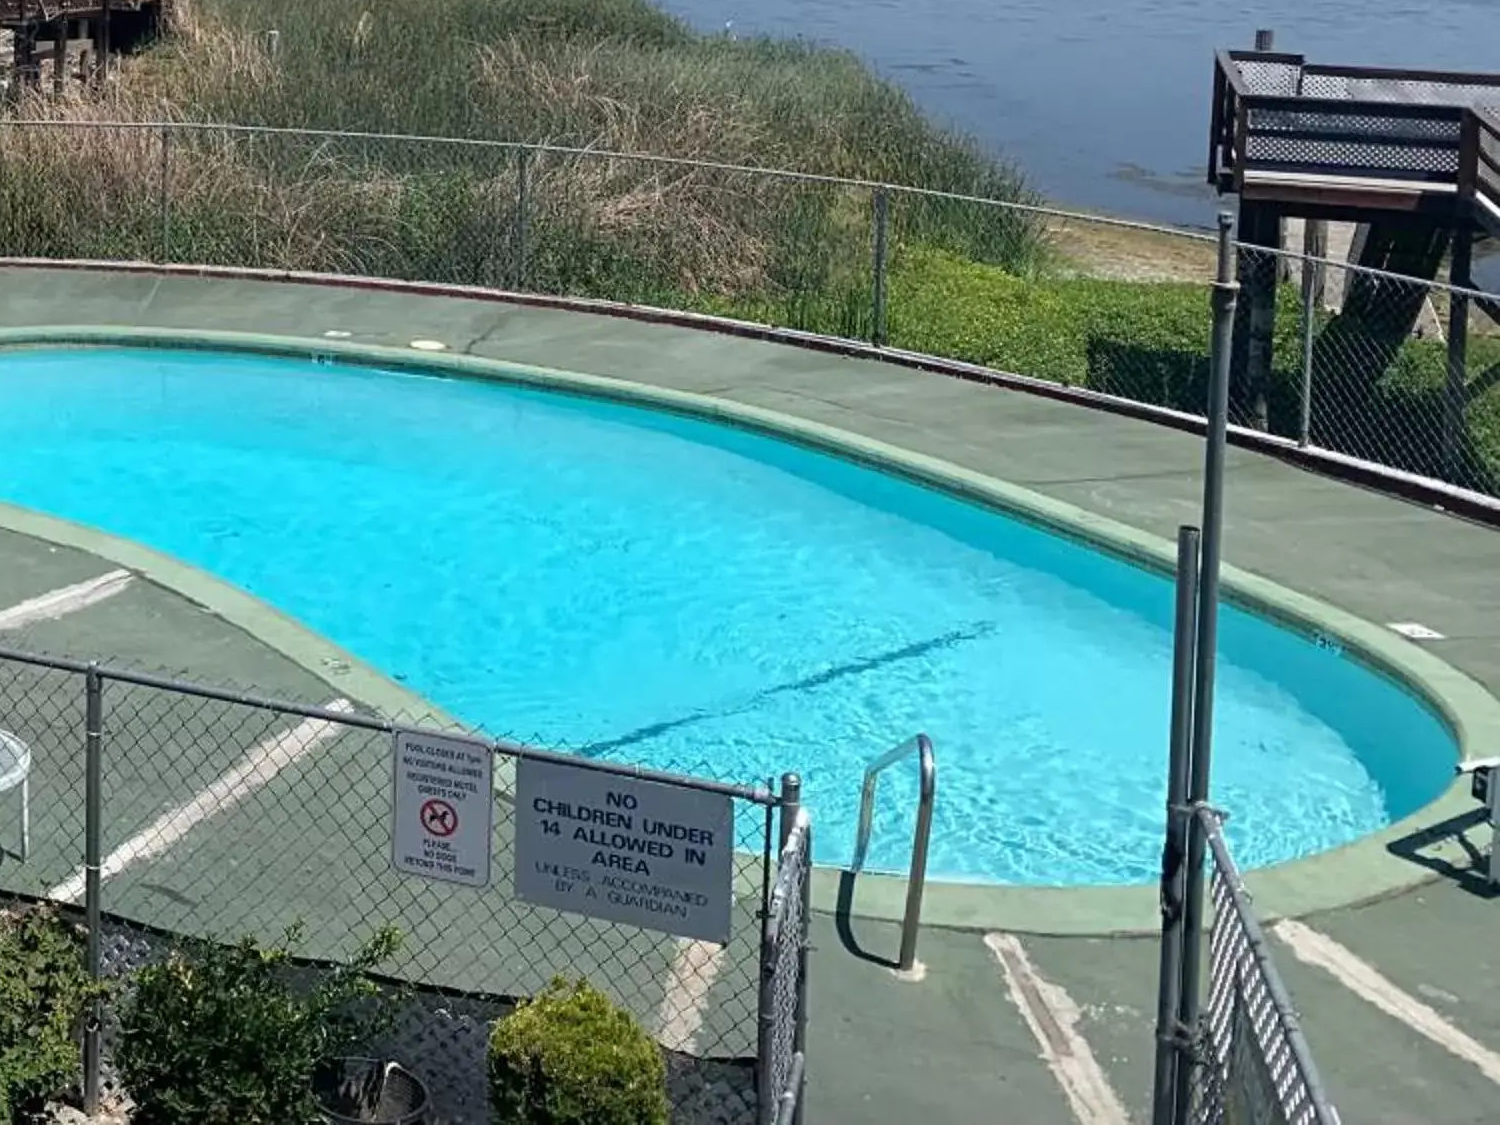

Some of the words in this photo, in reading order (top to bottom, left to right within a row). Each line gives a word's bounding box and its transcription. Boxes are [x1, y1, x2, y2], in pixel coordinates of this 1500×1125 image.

[533, 796, 633, 830] CHILDREN
[642, 818, 714, 847] UNDER
[606, 791, 638, 810] NO
[540, 819, 561, 836] 14
[573, 826, 674, 858] ALLOWED
[685, 847, 707, 867] IN
[591, 850, 650, 876] AREA
[535, 861, 591, 883] UNLESS
[602, 875, 708, 907] ACCOMPANIED
[554, 878, 575, 892] BY
[585, 885, 597, 900] A
[607, 890, 688, 918] GUARDIAN
